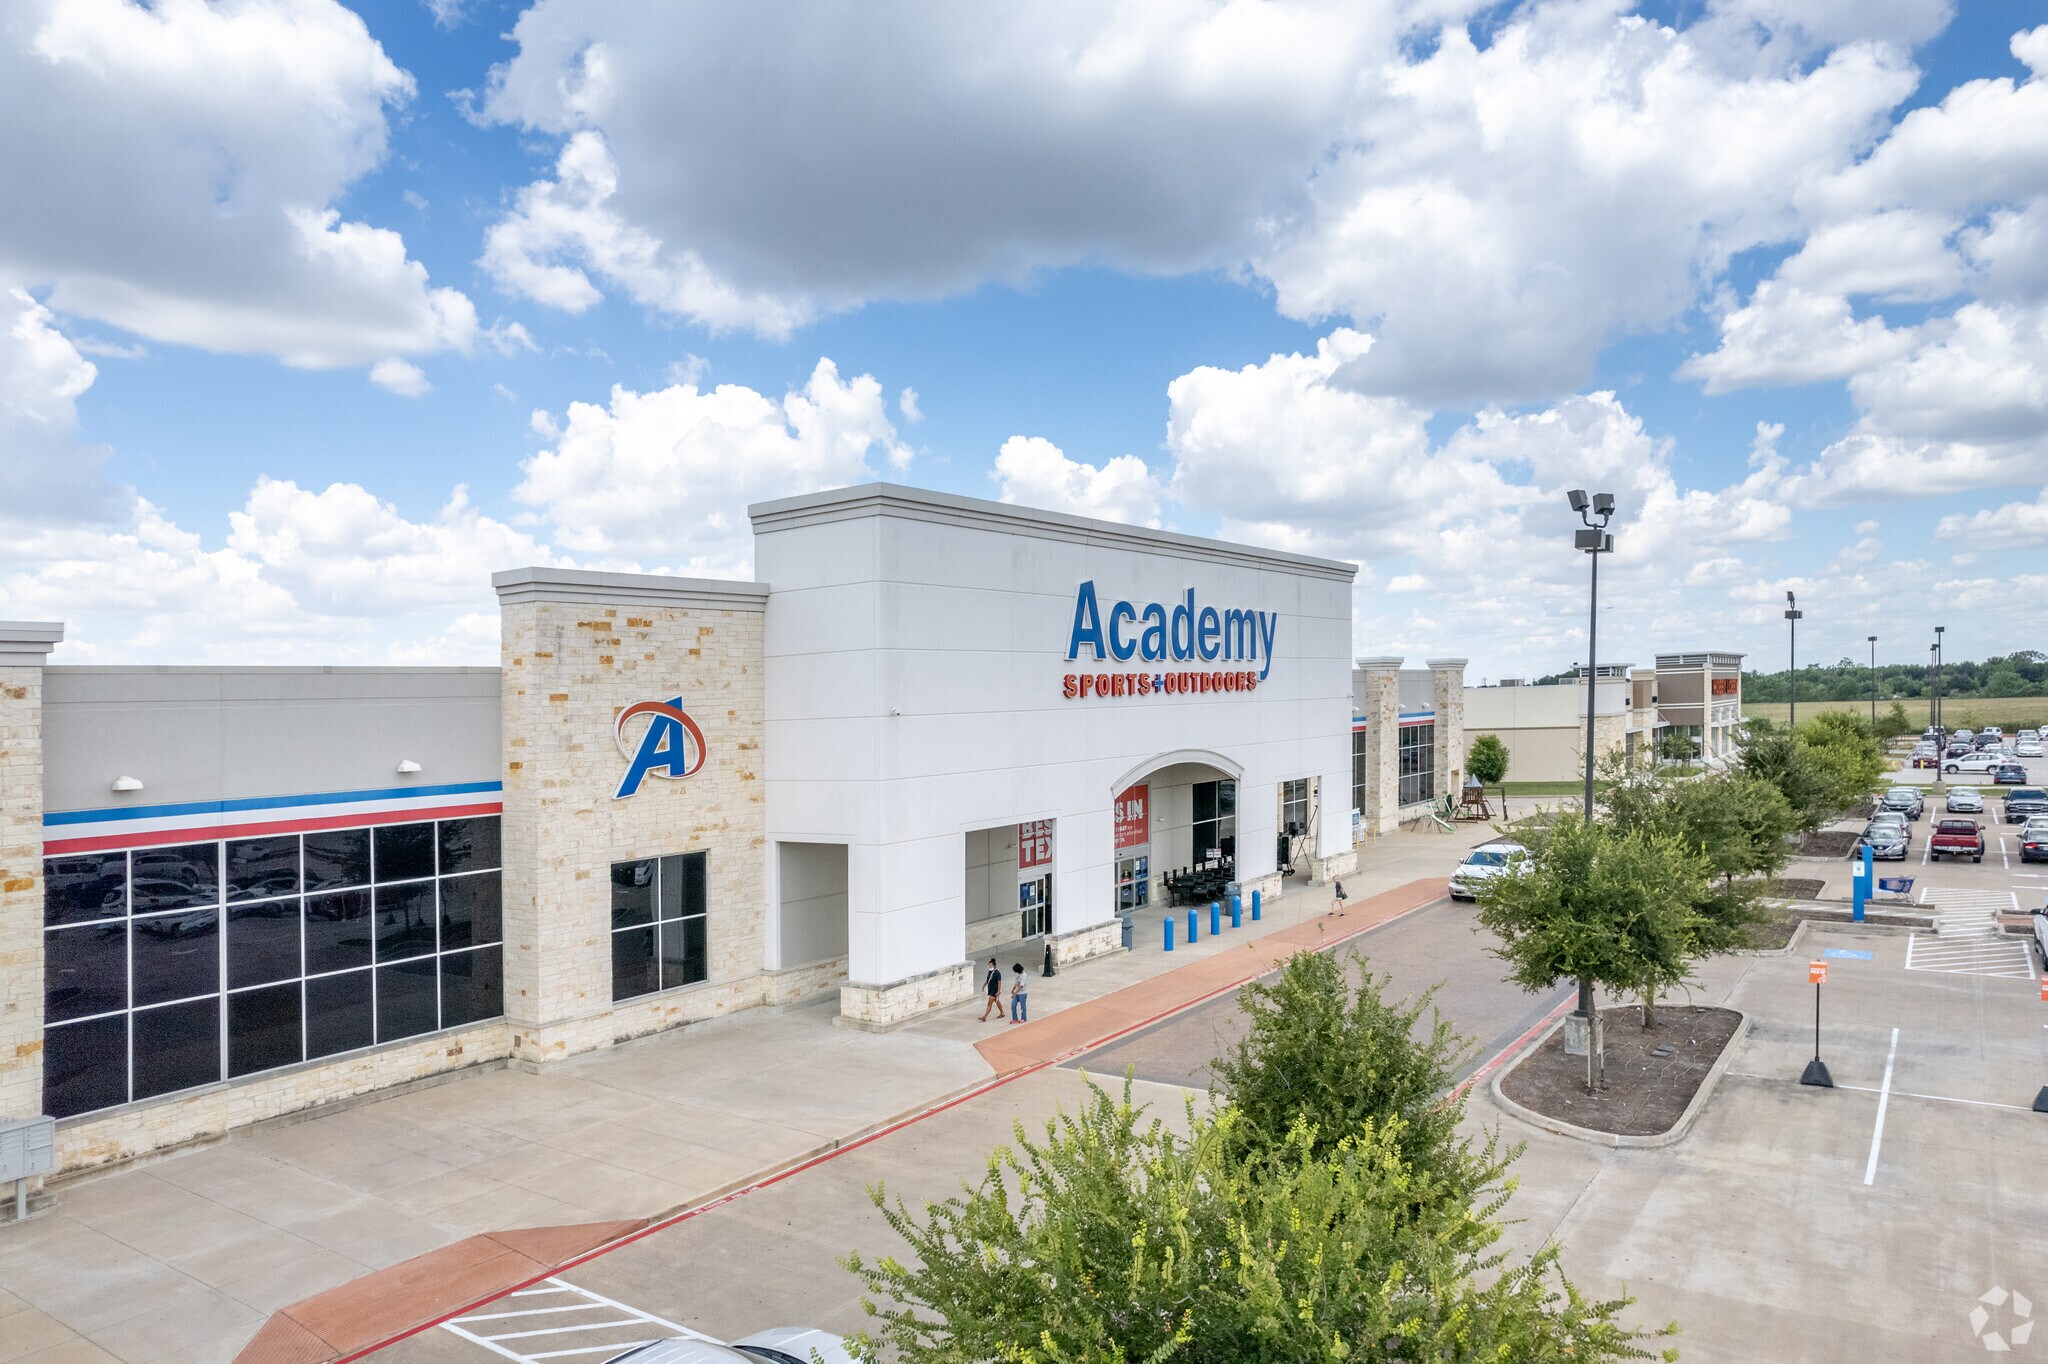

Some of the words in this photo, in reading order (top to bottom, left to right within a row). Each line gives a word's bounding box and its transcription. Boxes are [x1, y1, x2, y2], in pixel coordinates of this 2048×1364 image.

[1064, 579, 1278, 682] Academy
[612, 695, 700, 799] A
[1126, 798, 1144, 821] IN
